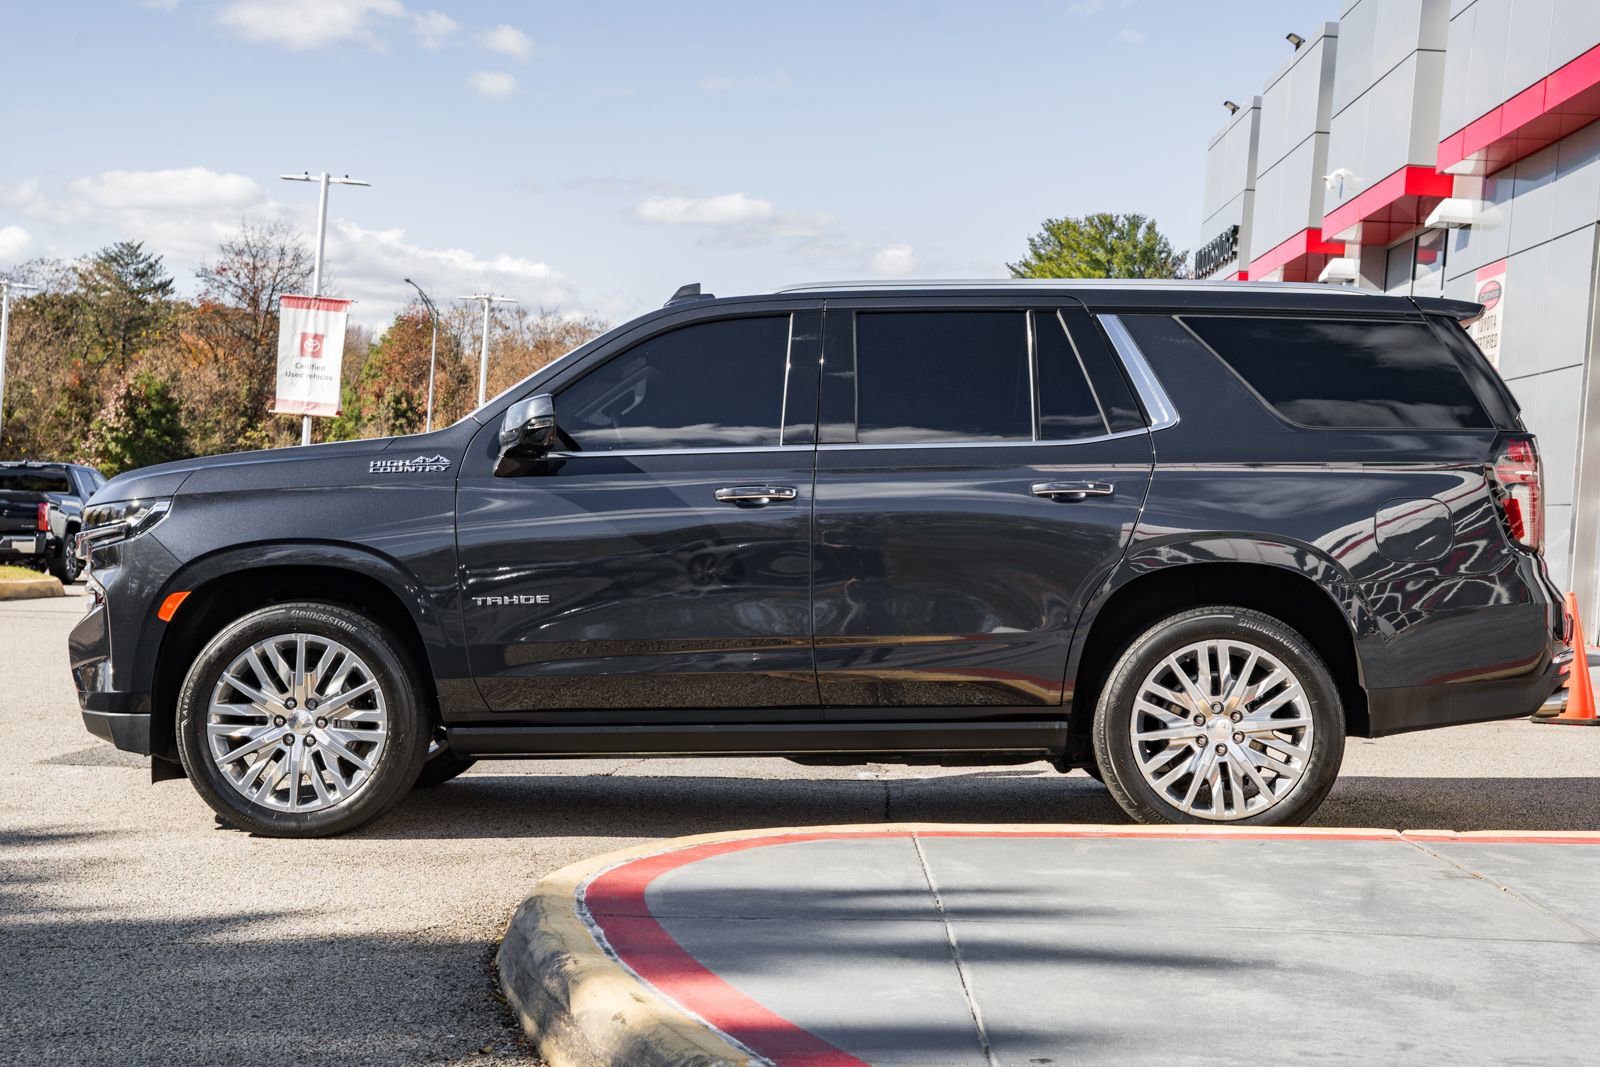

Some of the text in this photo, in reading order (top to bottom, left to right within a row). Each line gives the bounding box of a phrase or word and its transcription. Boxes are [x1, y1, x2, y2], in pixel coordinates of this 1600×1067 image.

[1475, 333, 1498, 350] ERTIFIED
[295, 362, 325, 371] Ceified
[369, 465, 451, 473] COUNTRY
[471, 594, 550, 606] TAHOE
[289, 609, 358, 634] BRIDGESTONE
[1237, 618, 1300, 655] BRIDGESTONE
